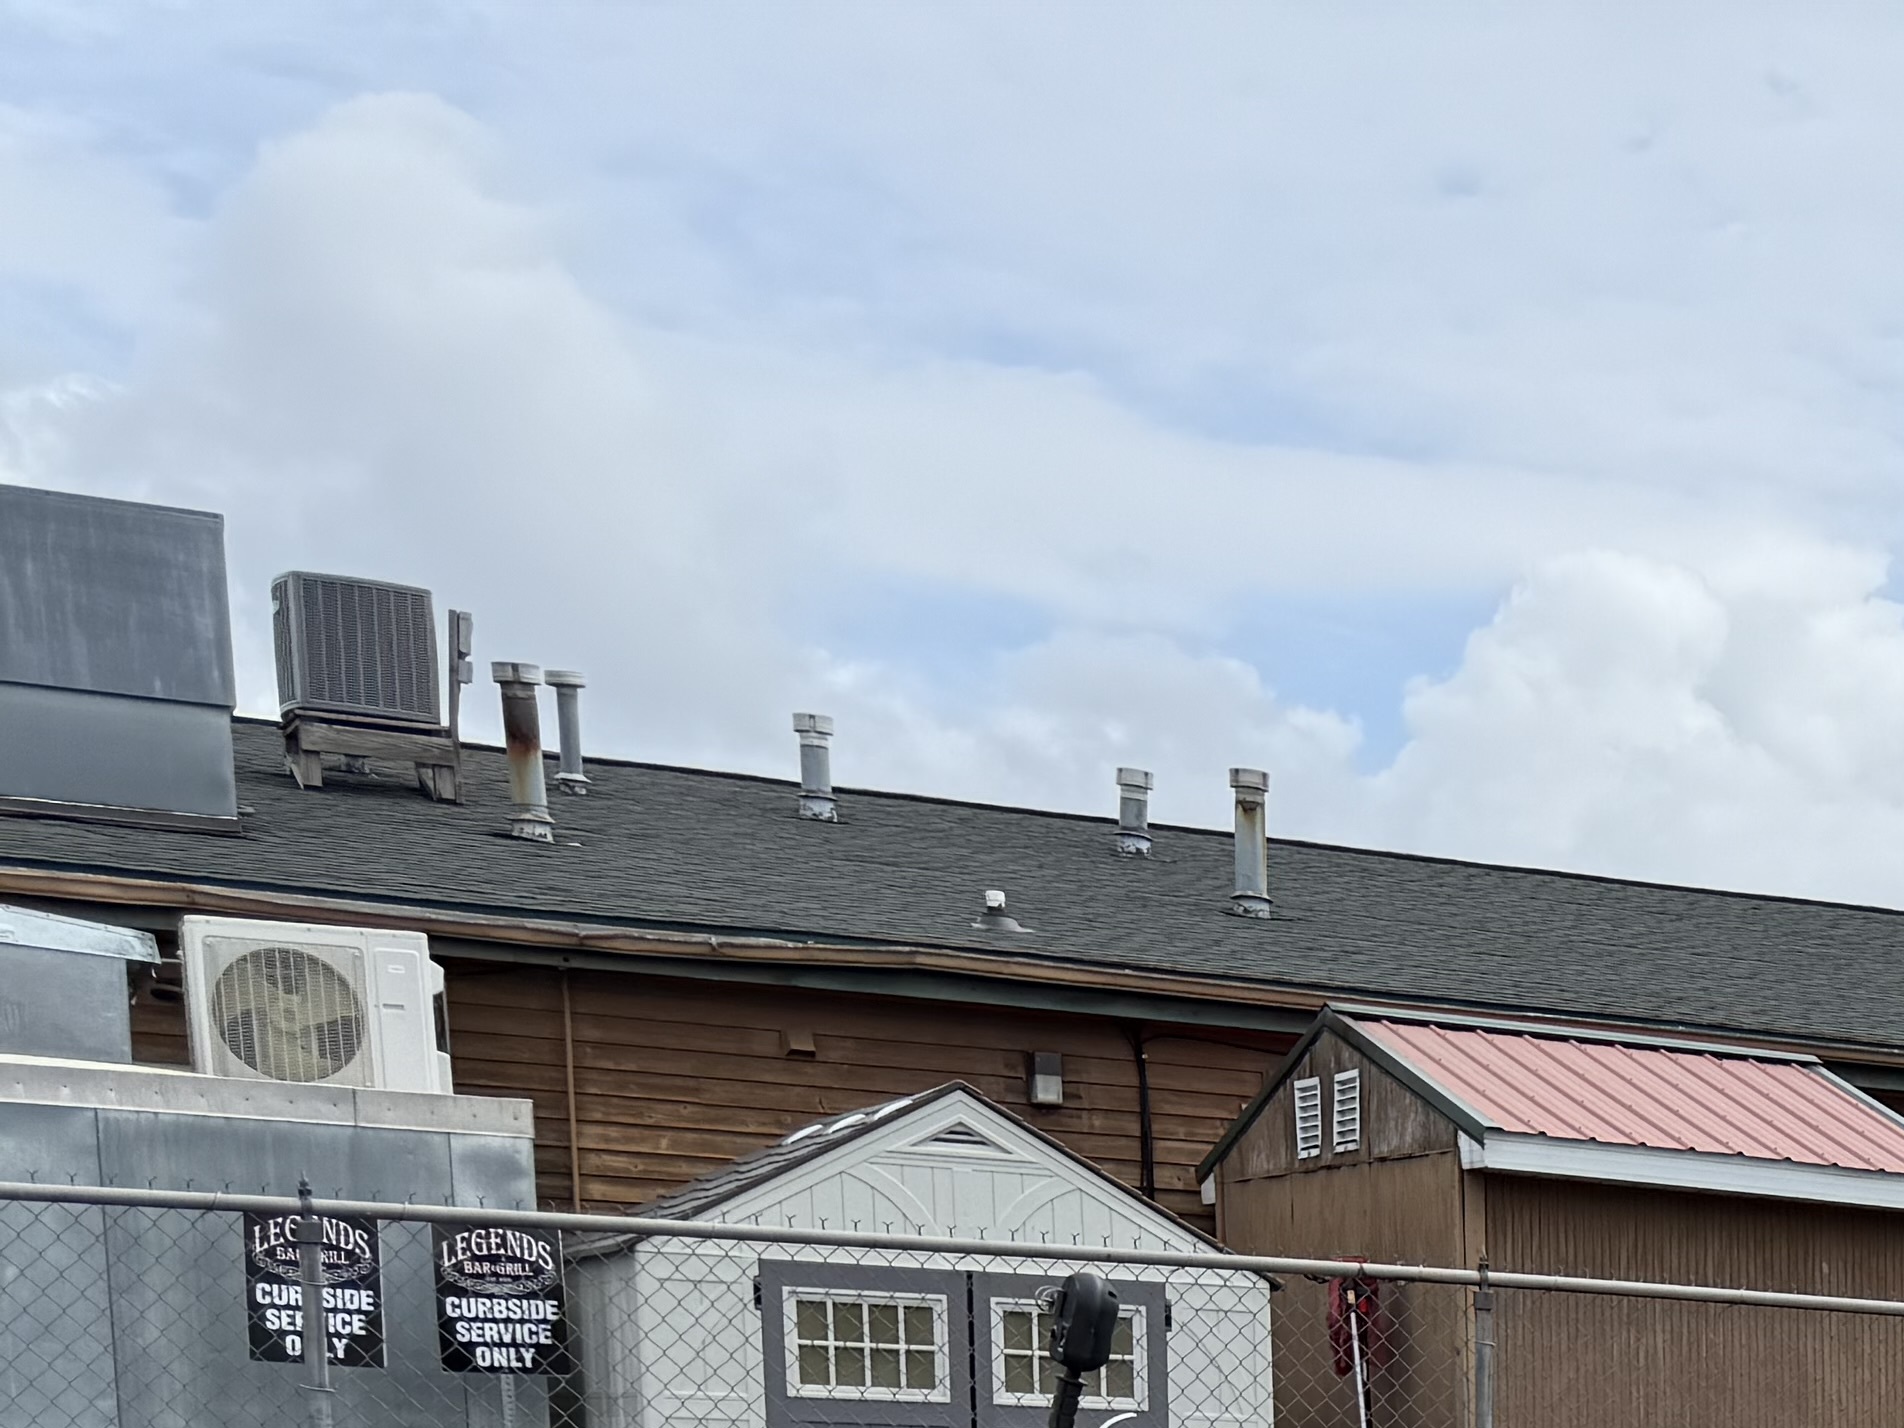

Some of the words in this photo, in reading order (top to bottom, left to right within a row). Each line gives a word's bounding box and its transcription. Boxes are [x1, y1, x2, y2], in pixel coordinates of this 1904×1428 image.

[253, 1214, 371, 1259] LEGNDS
[441, 1228, 554, 1270] LEGENDS
[255, 1282, 375, 1311] CURSIDE
[445, 1296, 560, 1321] CURBSIDE
[455, 1321, 553, 1345] SERVICE
[475, 1346, 536, 1369] ONLY
